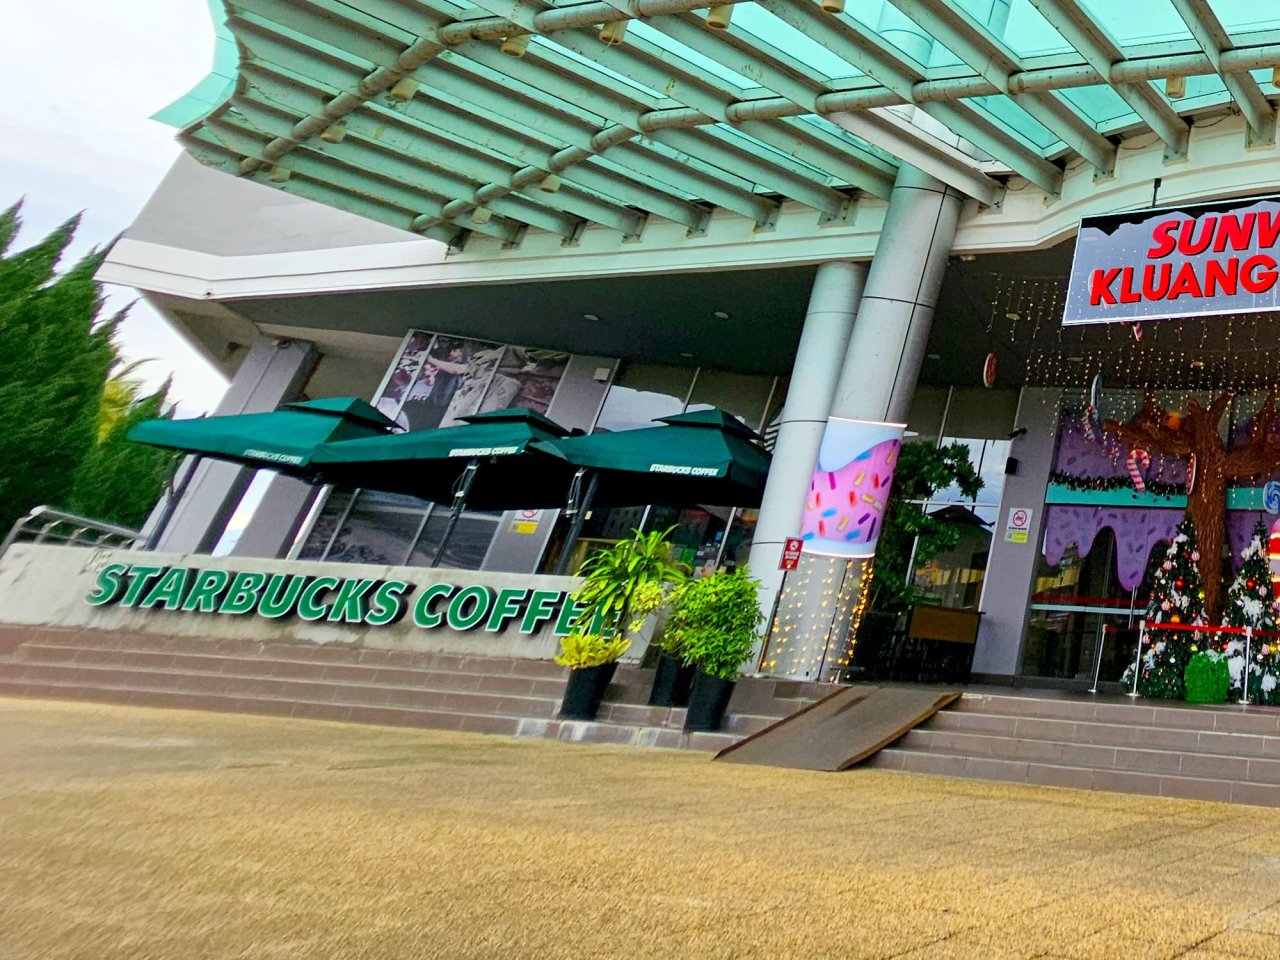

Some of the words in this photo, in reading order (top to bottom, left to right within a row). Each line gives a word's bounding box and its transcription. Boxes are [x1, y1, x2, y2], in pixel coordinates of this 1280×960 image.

[1090, 254, 1279, 306] KLUANG
[649, 463, 692, 475] STARBUCKS
[691, 466, 719, 477] COFFEE
[85, 563, 407, 626] STARBUCKS
